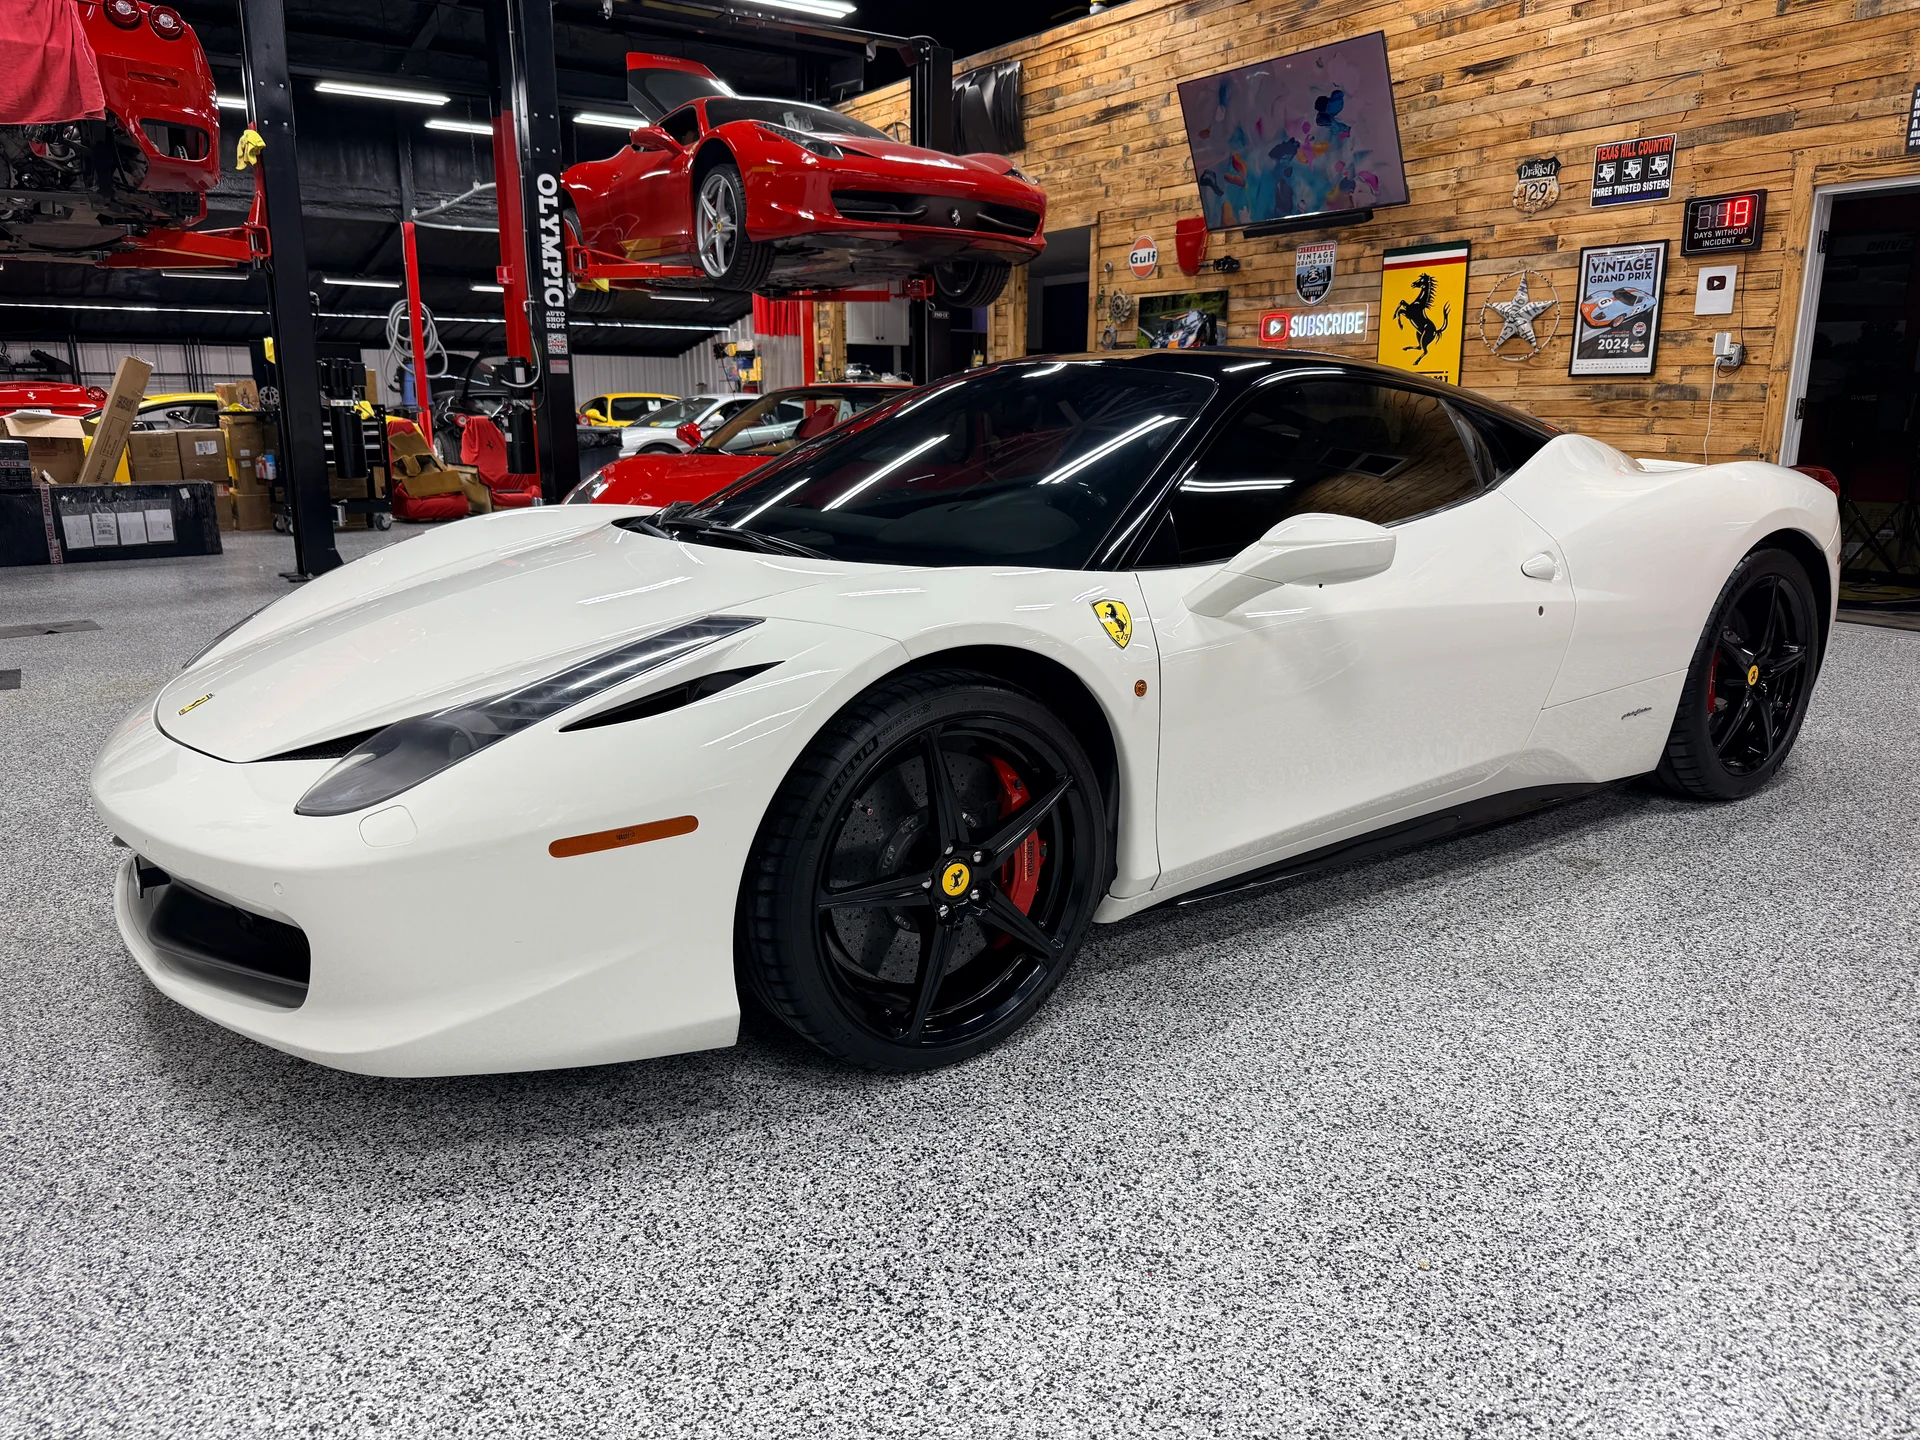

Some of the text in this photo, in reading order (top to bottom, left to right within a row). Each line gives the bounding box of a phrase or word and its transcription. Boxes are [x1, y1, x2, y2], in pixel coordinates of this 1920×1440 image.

[1597, 137, 1674, 162] TEXAS HILL COUNTRY
[1521, 161, 1555, 179] Dragon
[1523, 182, 1548, 202] 129
[1593, 179, 1670, 198] THREE TWISTED SISTERS
[537, 173, 565, 307] OLYMPIC
[1694, 227, 1748, 239] DAYS WITHOUT
[1702, 237, 1736, 247] INCIDENT
[1130, 251, 1157, 264] Gulf
[1297, 251, 1334, 260] VINTAGE
[1592, 258, 1654, 274] VINTAGE
[1590, 271, 1652, 284] GRAND PRIX
[1290, 312, 1365, 338] SUBSCRIBE
[1598, 338, 1630, 350] 2024
[42, 488, 51, 517] FRAGILE
[817, 737, 877, 818] MICHELIN
